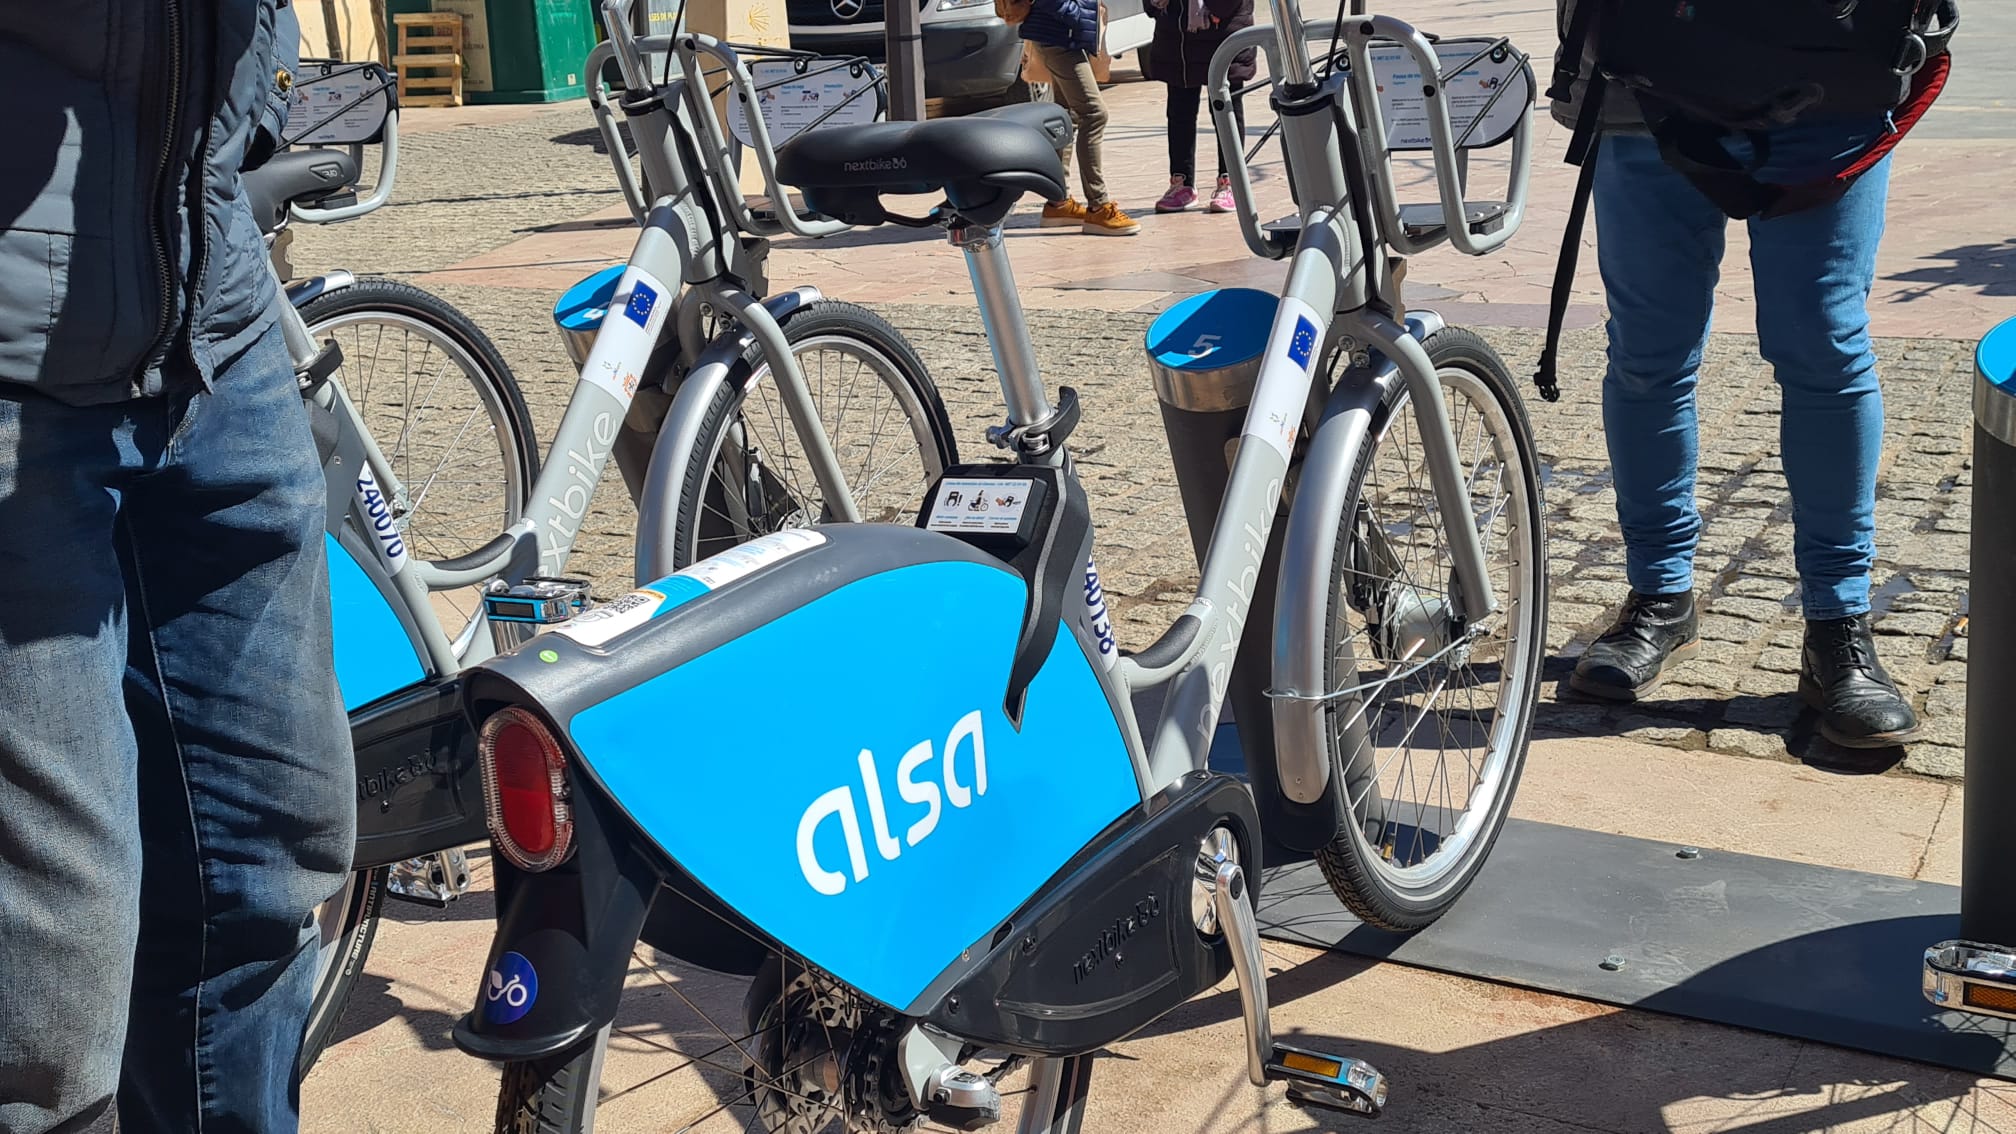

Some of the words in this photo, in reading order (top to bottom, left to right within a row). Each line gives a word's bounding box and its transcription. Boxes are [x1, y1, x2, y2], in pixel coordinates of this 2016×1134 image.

[1188, 334, 1222, 359] 5
[356, 471, 404, 558] 240070
[1084, 560, 1115, 655] 40138
[796, 709, 987, 896] alsa
